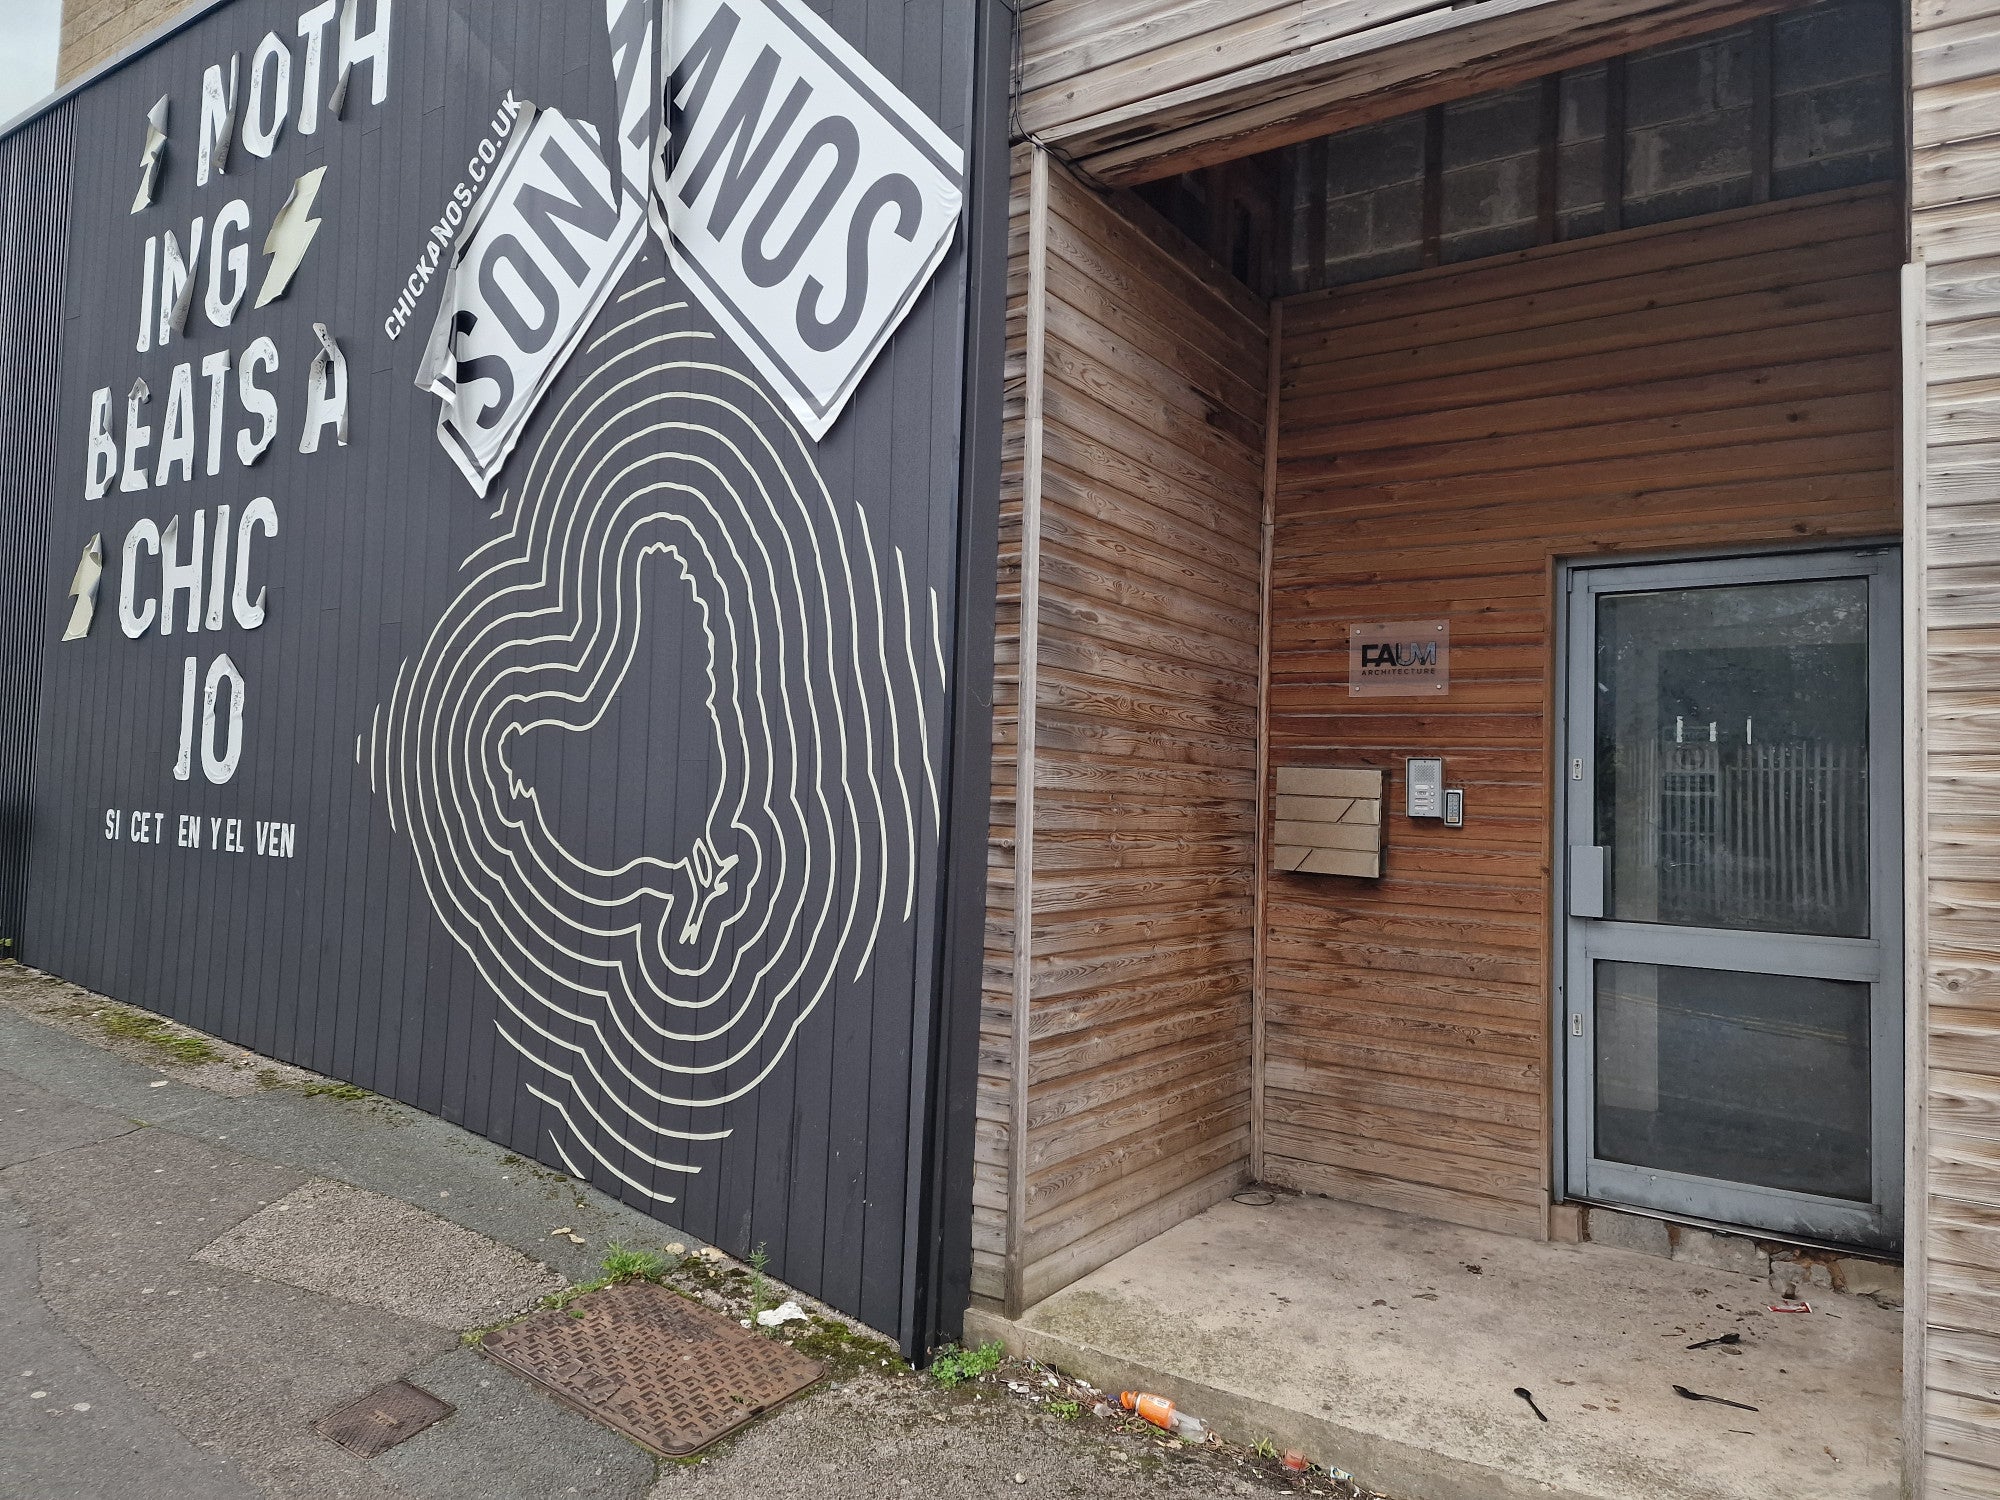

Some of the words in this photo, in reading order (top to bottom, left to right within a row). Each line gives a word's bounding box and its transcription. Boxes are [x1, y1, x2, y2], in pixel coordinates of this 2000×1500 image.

[136, 199, 250, 353] ING
[384, 89, 523, 341] CHICKANOS.CO.UK
[84, 336, 280, 500] BEATS
[298, 322, 348, 454] A
[118, 496, 279, 640] CHIC
[1361, 668, 1436, 676] ARCHITECTURE
